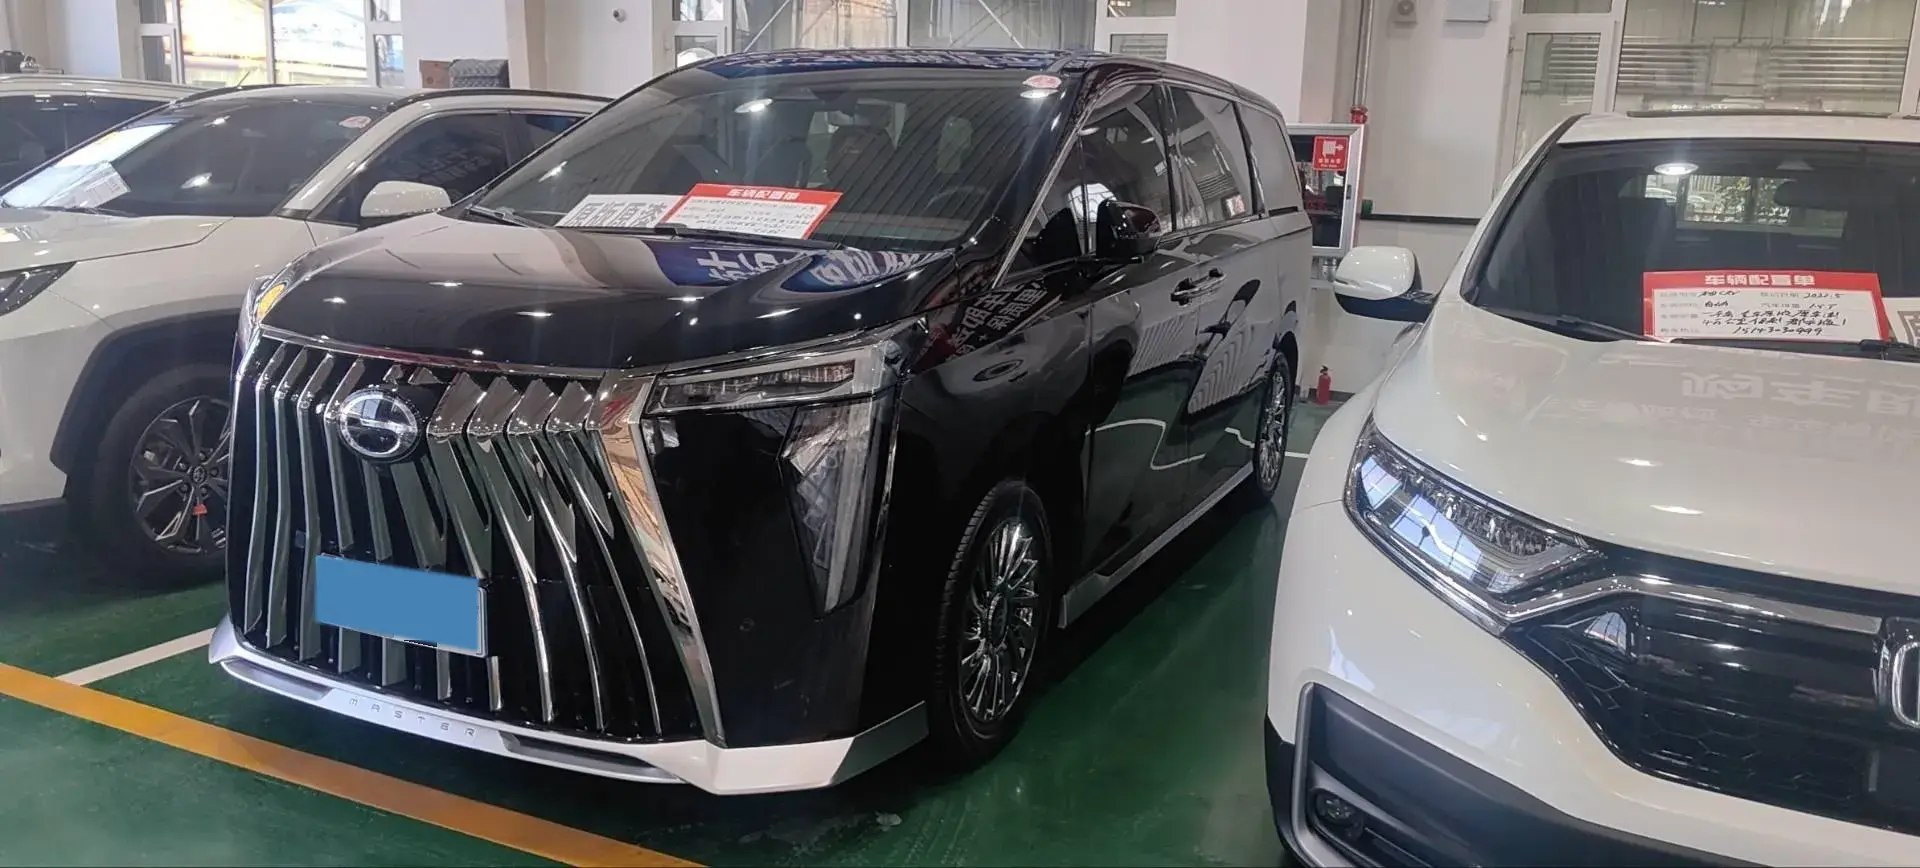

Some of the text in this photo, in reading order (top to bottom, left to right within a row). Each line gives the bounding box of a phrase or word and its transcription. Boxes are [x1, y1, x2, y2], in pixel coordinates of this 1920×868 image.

[1704, 274, 1816, 287] 车辆配置单
[349, 698, 475, 737] MASTER
